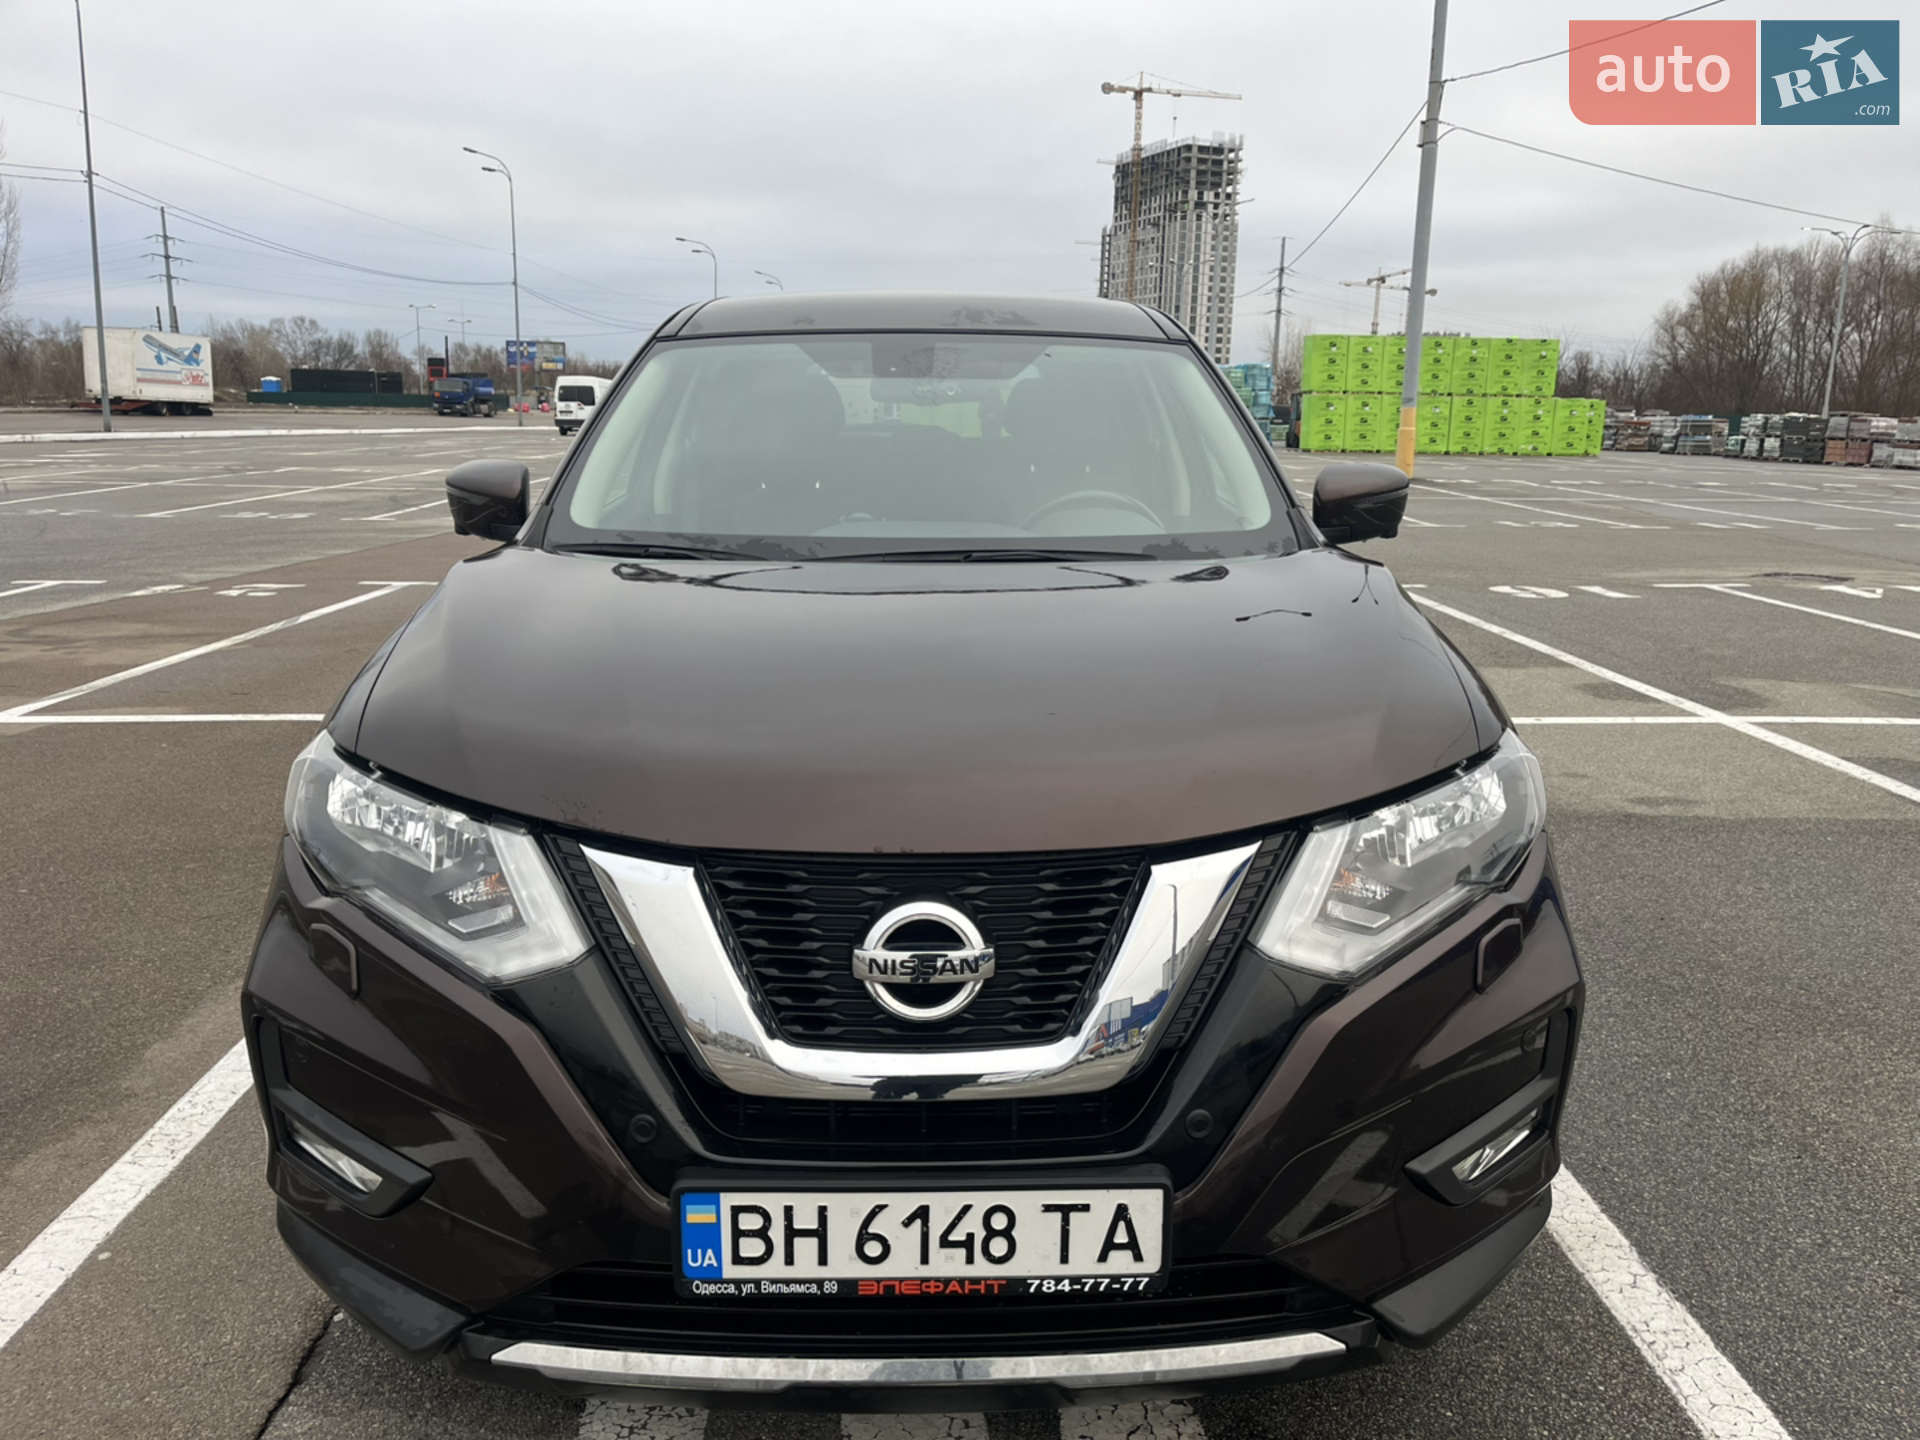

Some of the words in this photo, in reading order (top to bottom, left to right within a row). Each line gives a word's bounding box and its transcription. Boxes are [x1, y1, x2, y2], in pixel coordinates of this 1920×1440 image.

[868, 958, 980, 977] NISSAN
[729, 1204, 828, 1266] BH
[854, 1204, 1016, 1264] 6148
[1041, 1203, 1144, 1264] TA
[687, 1250, 717, 1268] UA
[692, 1280, 738, 1296] Одесса,
[741, 1281, 758, 1296] ул.
[761, 1280, 820, 1296] Вильямса,
[823, 1280, 838, 1294] 89
[858, 1279, 1007, 1296] ЭЛЕФАНТ
[1027, 1277, 1150, 1293] 784-77-77
